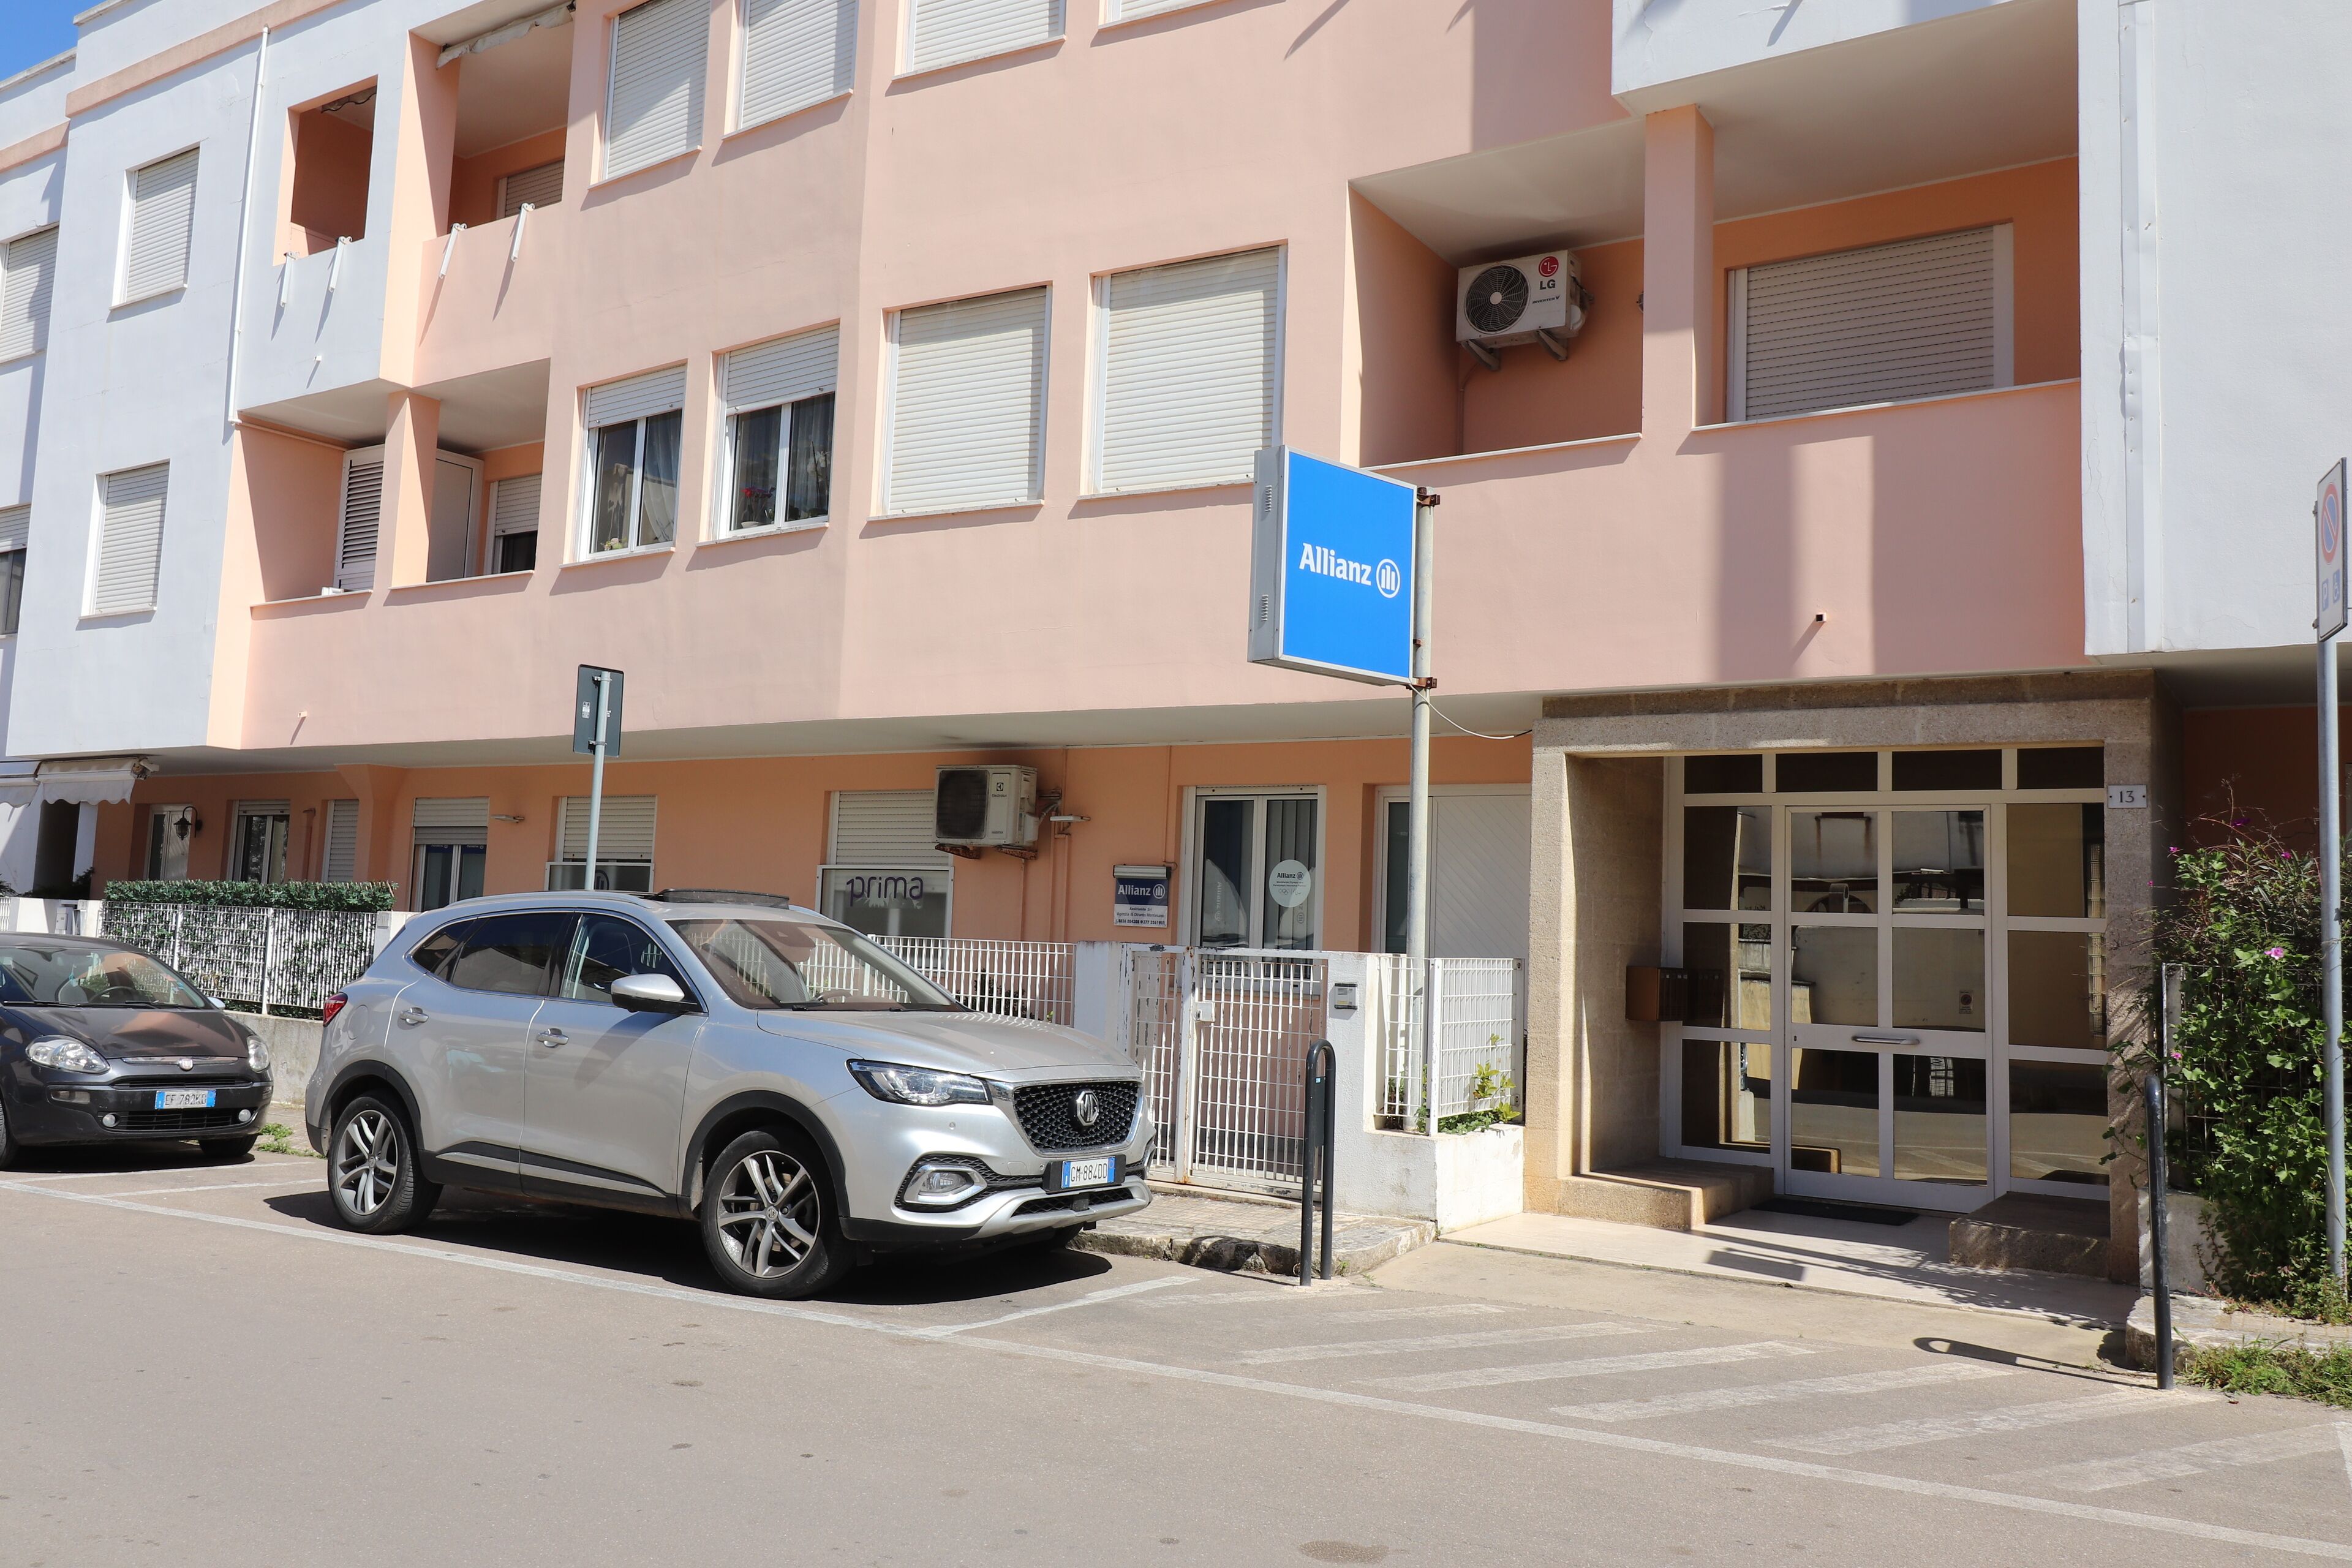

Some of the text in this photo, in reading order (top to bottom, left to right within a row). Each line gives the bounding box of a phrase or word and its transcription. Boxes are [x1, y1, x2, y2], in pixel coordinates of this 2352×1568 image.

[1539, 279, 1556, 290] LG
[1299, 543, 1372, 586] Allianz
[2119, 790, 2135, 803] 13
[846, 876, 924, 907] prima
[1118, 884, 1151, 896] Allianz
[1083, 1163, 1107, 1180] 884DD
